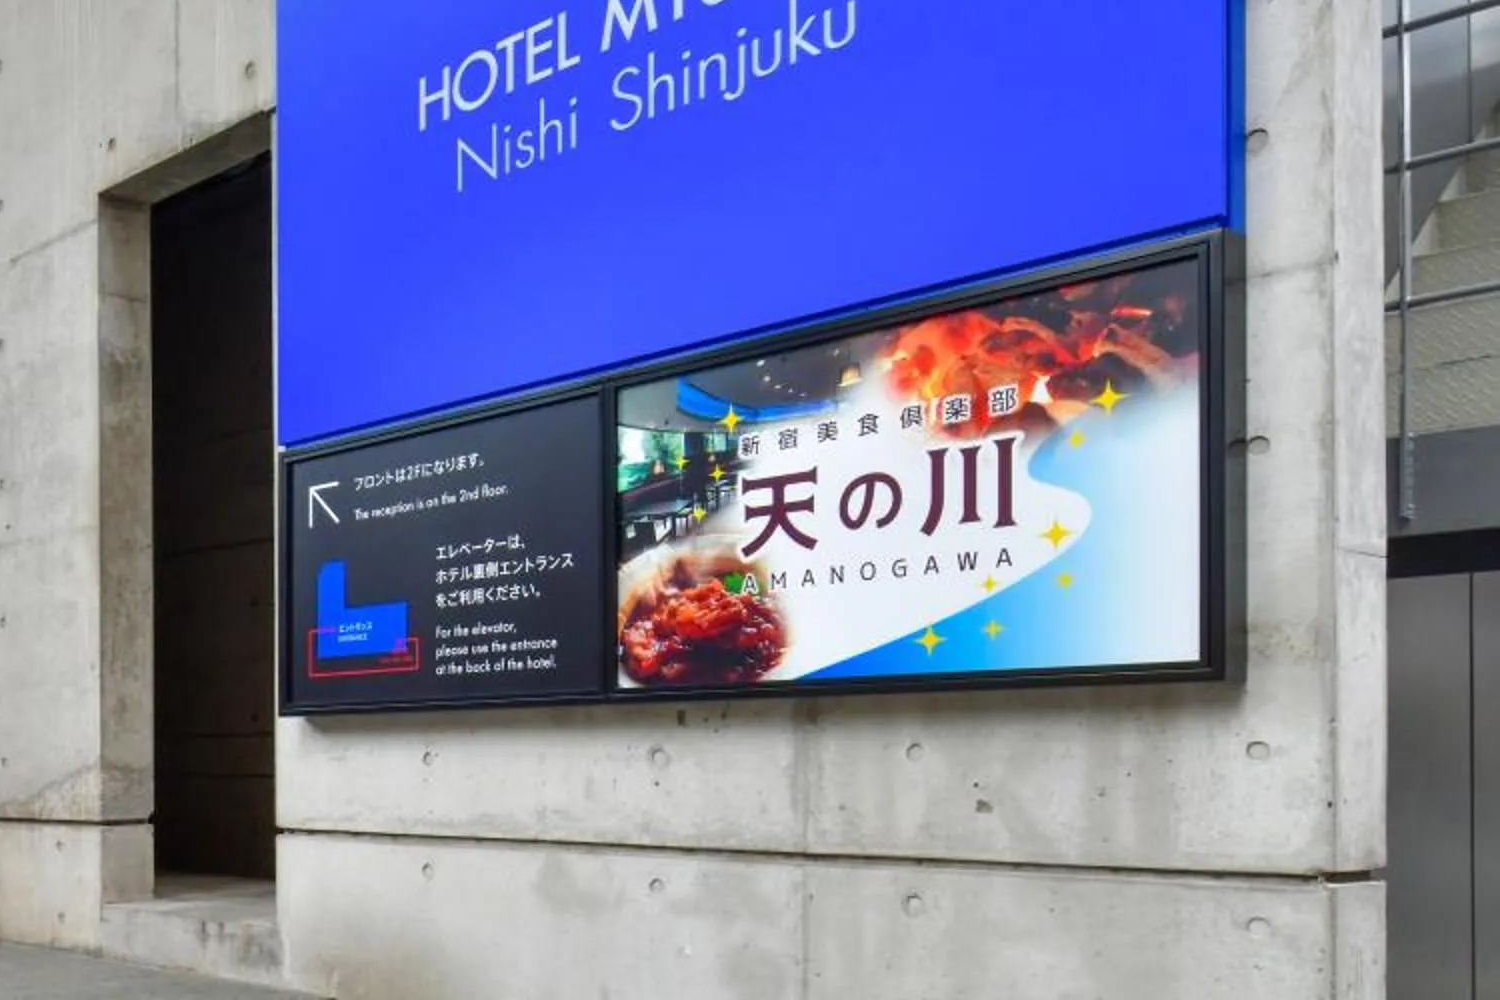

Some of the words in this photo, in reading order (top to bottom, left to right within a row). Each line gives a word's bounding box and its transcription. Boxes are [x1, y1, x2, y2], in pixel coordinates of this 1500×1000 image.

[418, 11, 581, 132] HOTEL
[456, 96, 578, 193] Nishi
[354, 508, 369, 521] The
[371, 500, 415, 519] reception
[425, 498, 438, 509] on
[441, 490, 457, 506] the
[459, 485, 479, 503] 2nd
[740, 437, 1019, 558] 天の川
[741, 547, 1013, 594] AMANOGAWA
[435, 625, 452, 639] For
[453, 623, 469, 637] the
[435, 644, 469, 660] please
[471, 644, 489, 655] use
[491, 640, 507, 653] the
[510, 638, 558, 652] entrance
[447, 661, 463, 675] the
[465, 659, 490, 673] back
[493, 658, 505, 671] of
[507, 657, 523, 671] the
